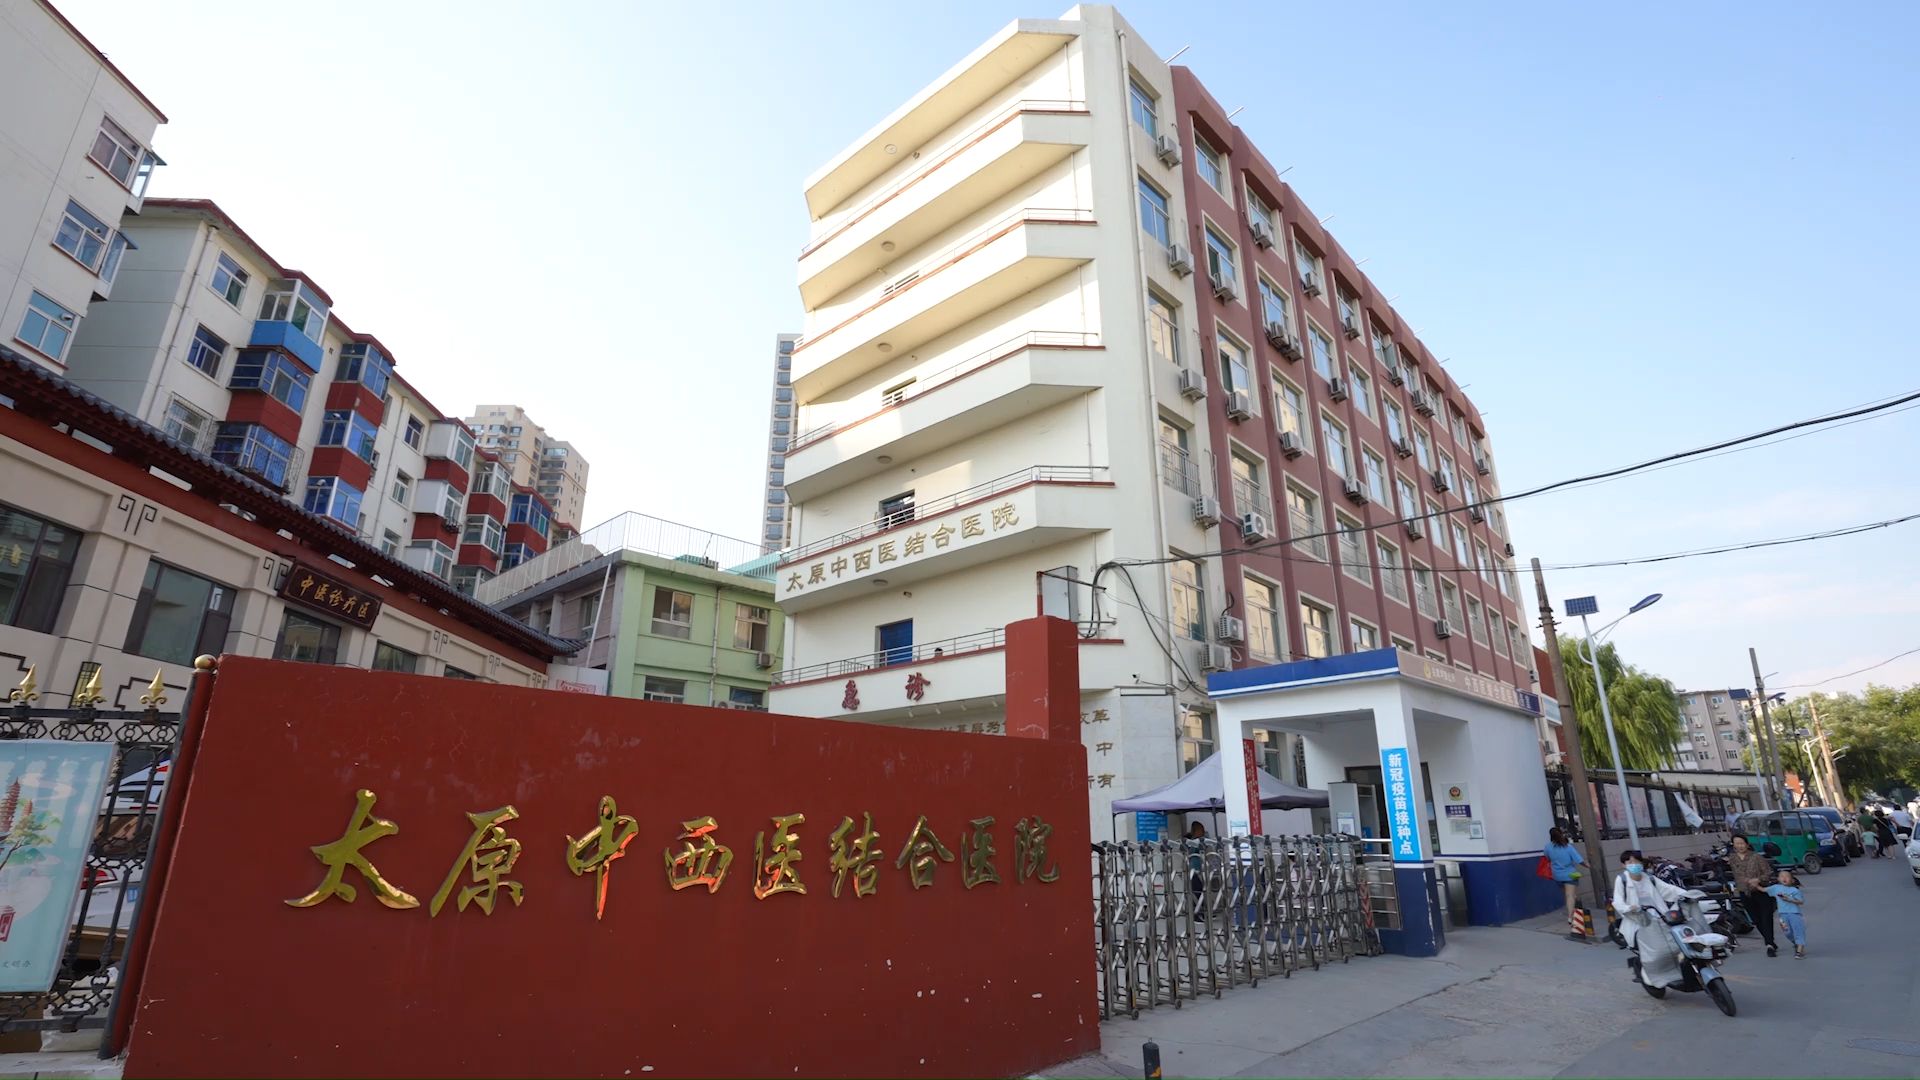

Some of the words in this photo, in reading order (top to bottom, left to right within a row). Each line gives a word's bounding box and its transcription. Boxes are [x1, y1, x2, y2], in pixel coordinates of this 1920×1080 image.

[785, 502, 1019, 592] 太原中西医结合医院
[299, 575, 371, 618] 中医诊疗区
[842, 672, 931, 711] 急诊
[1096, 742, 1113, 756] 中
[1388, 753, 1414, 855] 新冠疫苗接种点
[283, 789, 1060, 921] 太原中西医结合医院
